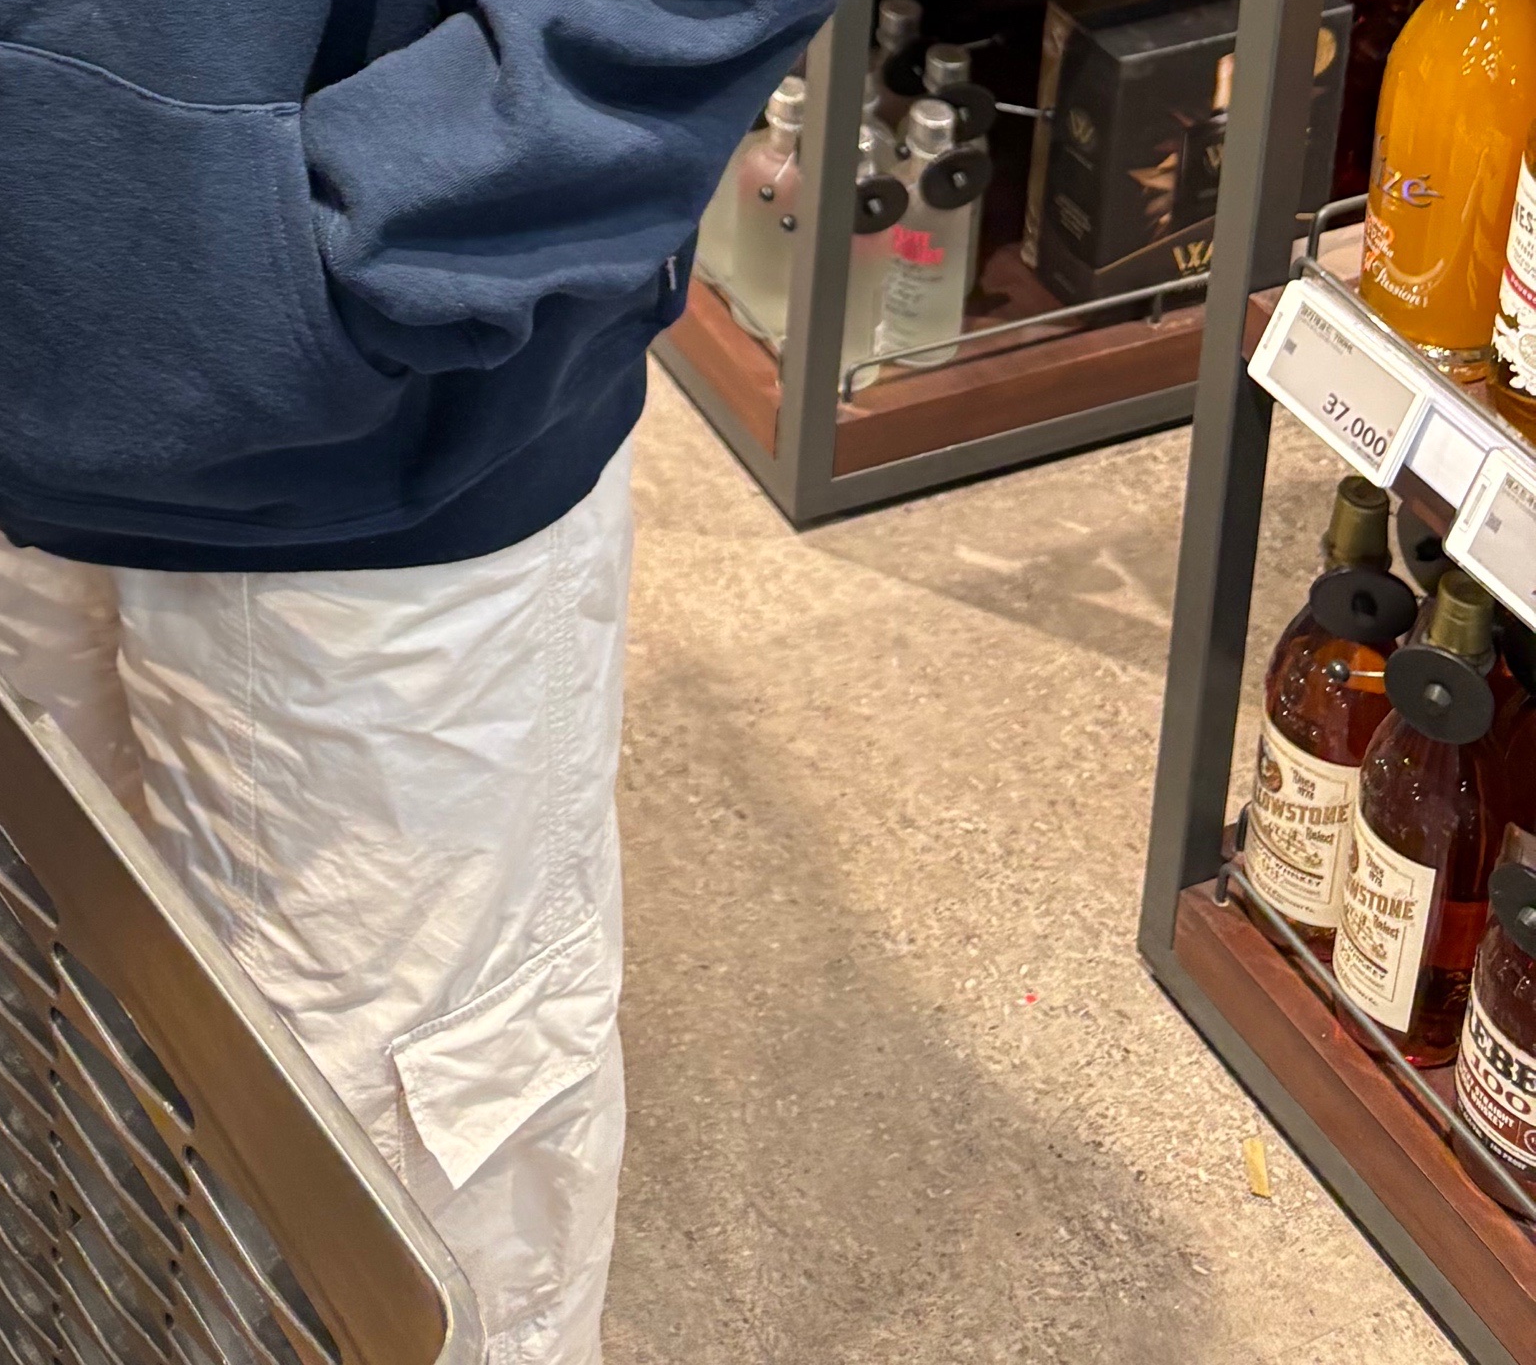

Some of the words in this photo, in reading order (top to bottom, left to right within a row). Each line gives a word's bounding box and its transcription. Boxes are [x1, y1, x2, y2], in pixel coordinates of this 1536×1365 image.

[1471, 1051, 1532, 1116] 100
[1470, 1094, 1505, 1131] WHISKEY
[1474, 1085, 1516, 1128] STRAIGHT
